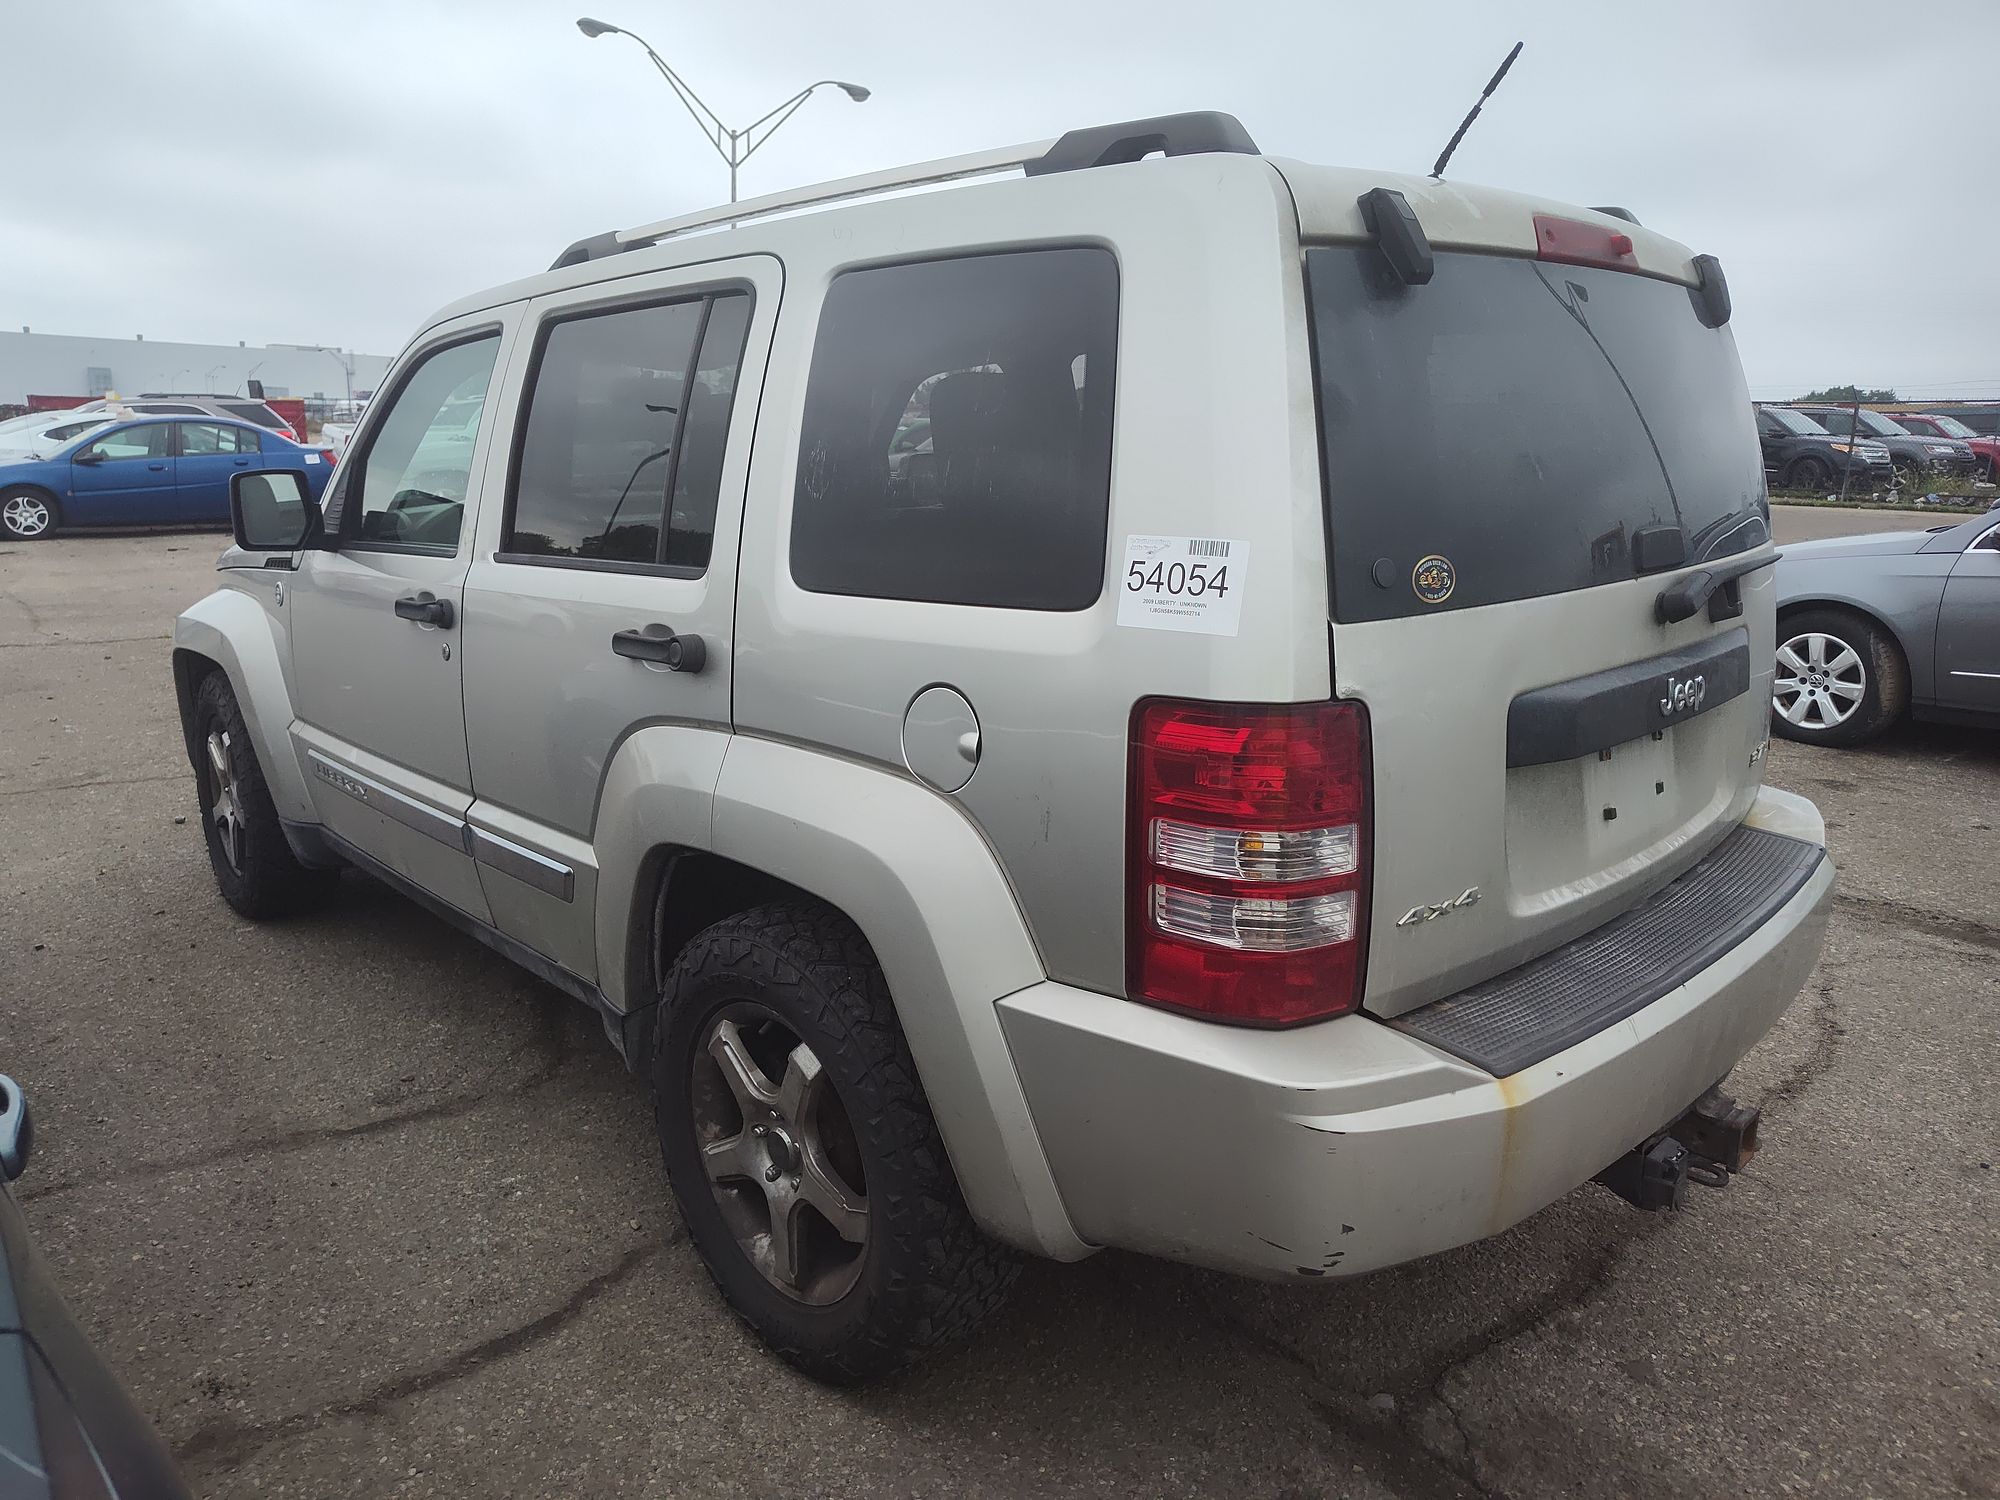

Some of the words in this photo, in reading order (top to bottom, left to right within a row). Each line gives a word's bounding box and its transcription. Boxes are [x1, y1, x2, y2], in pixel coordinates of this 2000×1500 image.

[1127, 560, 1229, 598] 54054
[1180, 601, 1207, 609] UNKNOWN
[1660, 675, 1706, 715] Jeep
